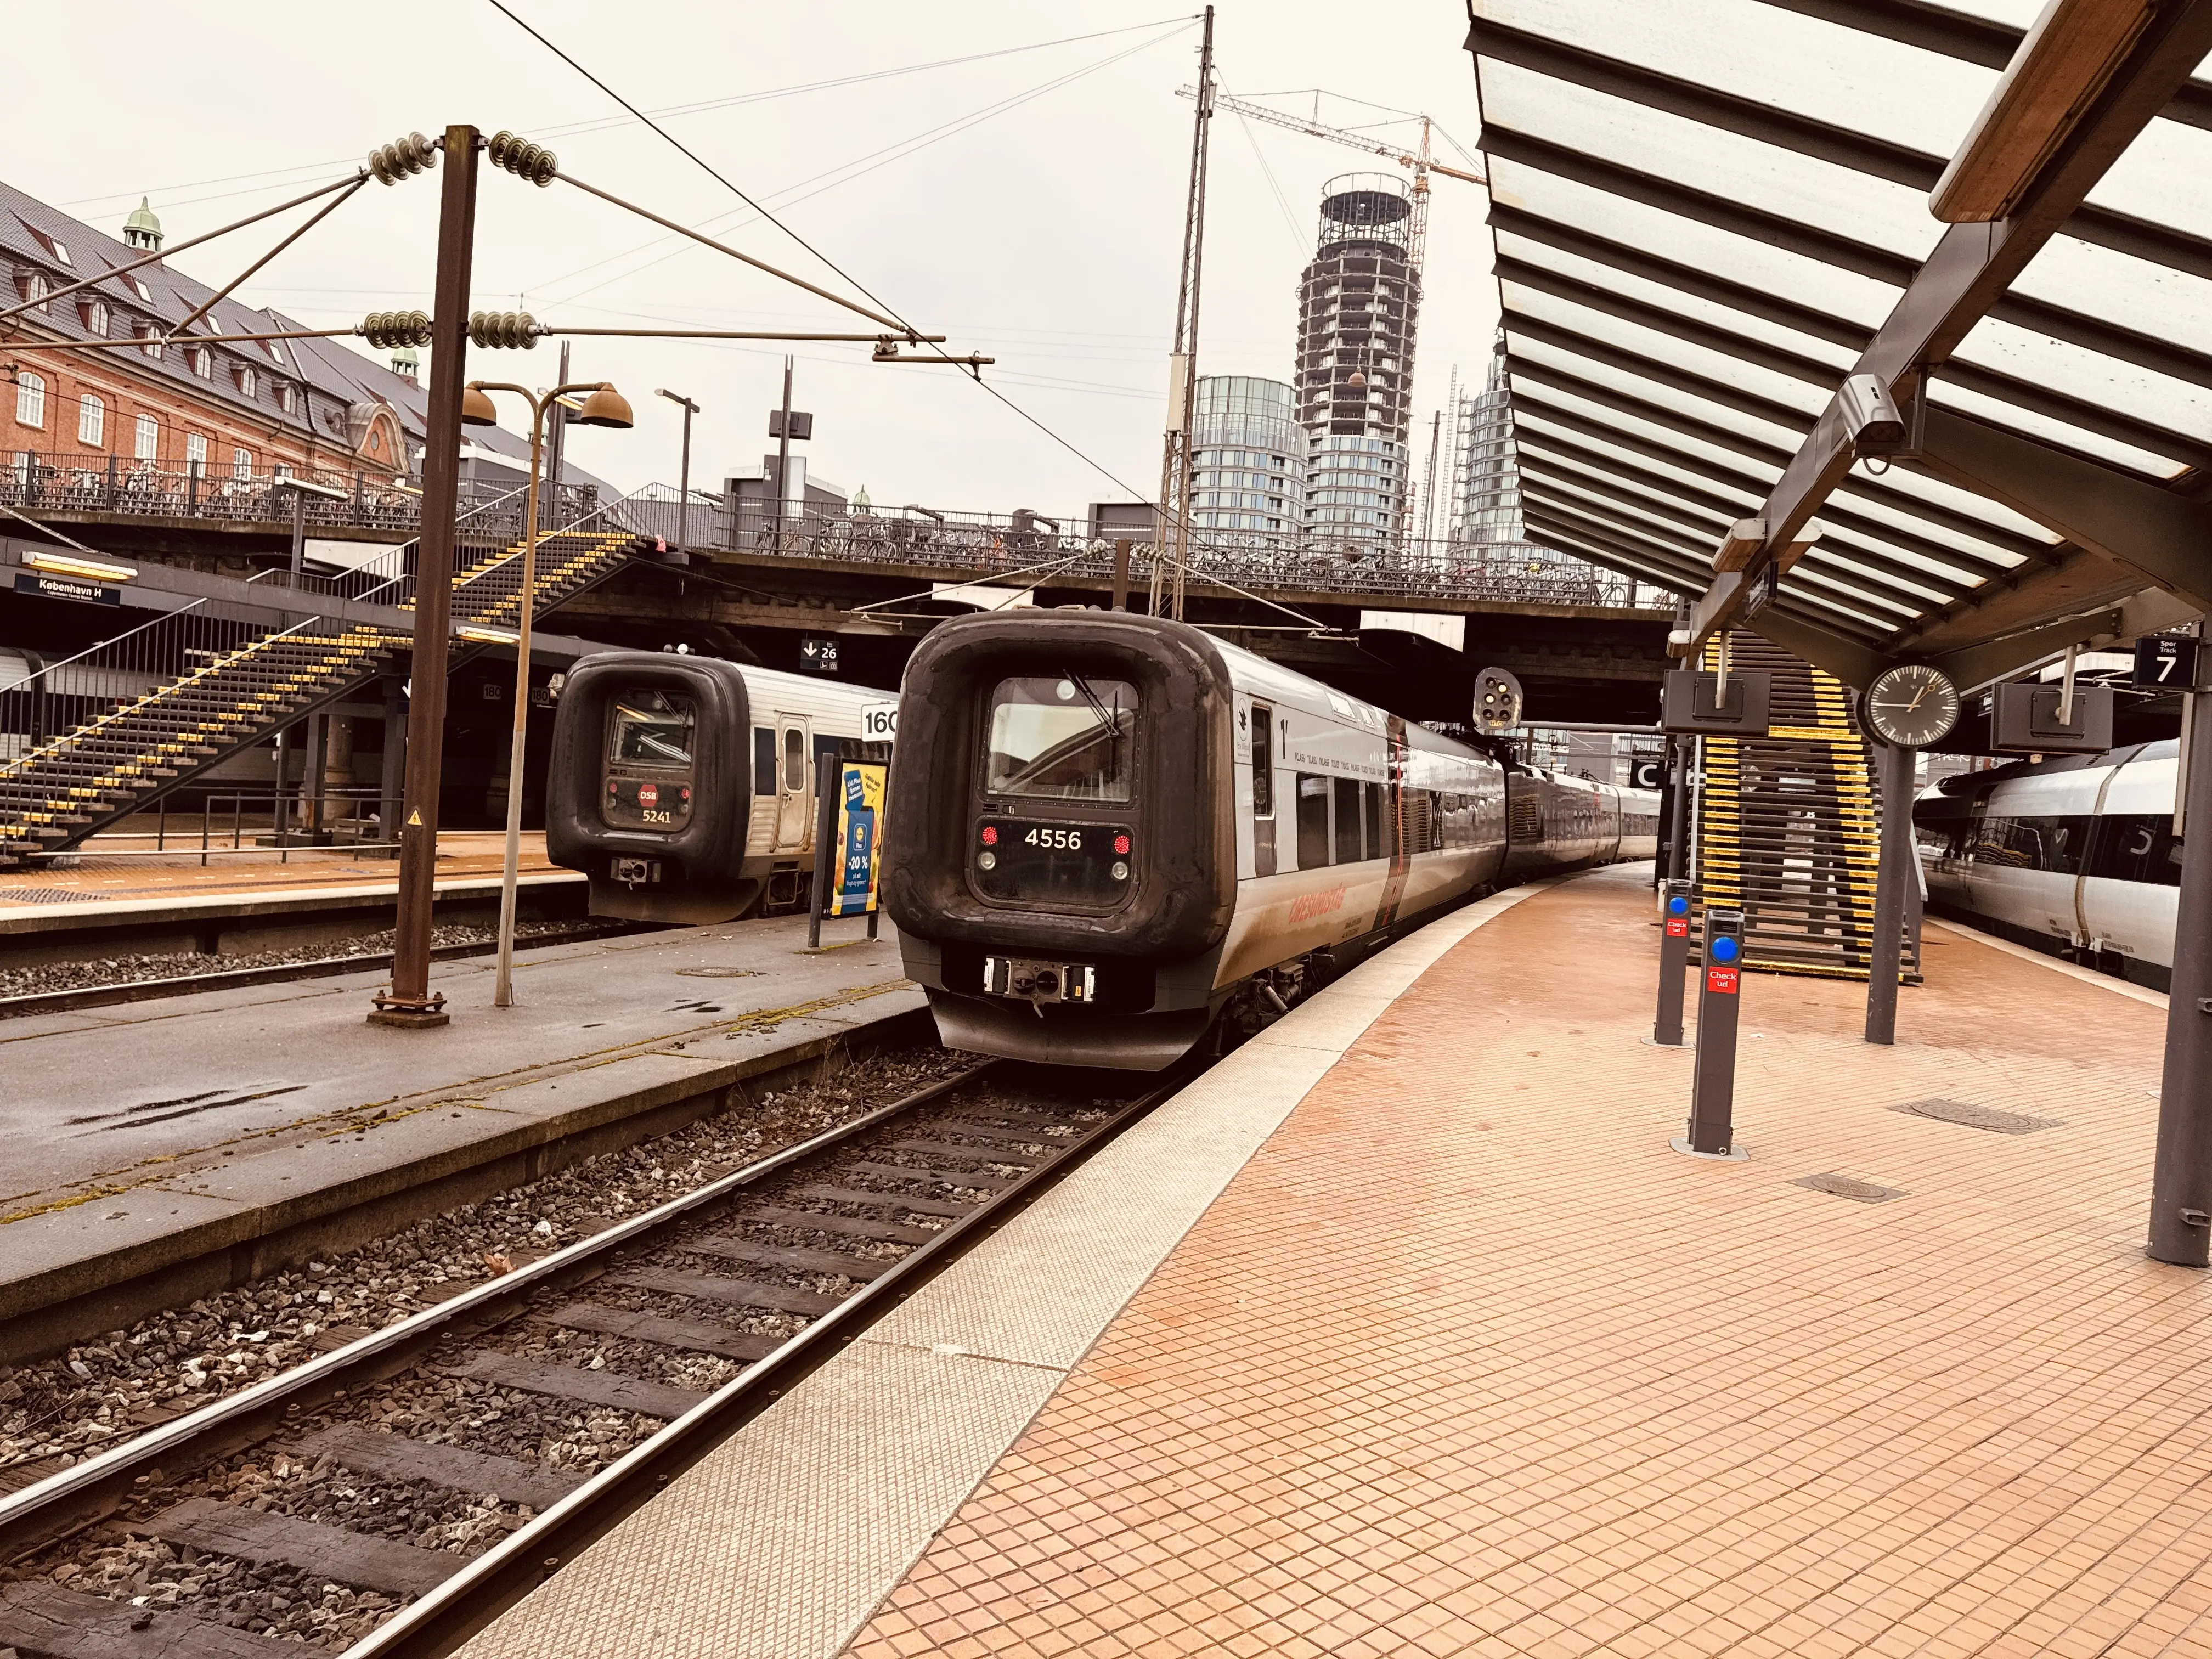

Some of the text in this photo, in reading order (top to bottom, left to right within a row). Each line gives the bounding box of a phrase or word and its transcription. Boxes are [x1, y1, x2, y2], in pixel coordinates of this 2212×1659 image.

[40, 579, 92, 596] København
[94, 588, 101, 597] H
[821, 647, 837, 659] 26
[2157, 656, 2176, 682] 7
[532, 689, 548, 701] 180
[1638, 764, 1657, 787] C
[640, 791, 657, 800] DSB
[642, 810, 671, 823] 5241
[1025, 828, 1081, 850] 4556
[848, 855, 868, 870] -20 %
[1709, 971, 1737, 980] Check
